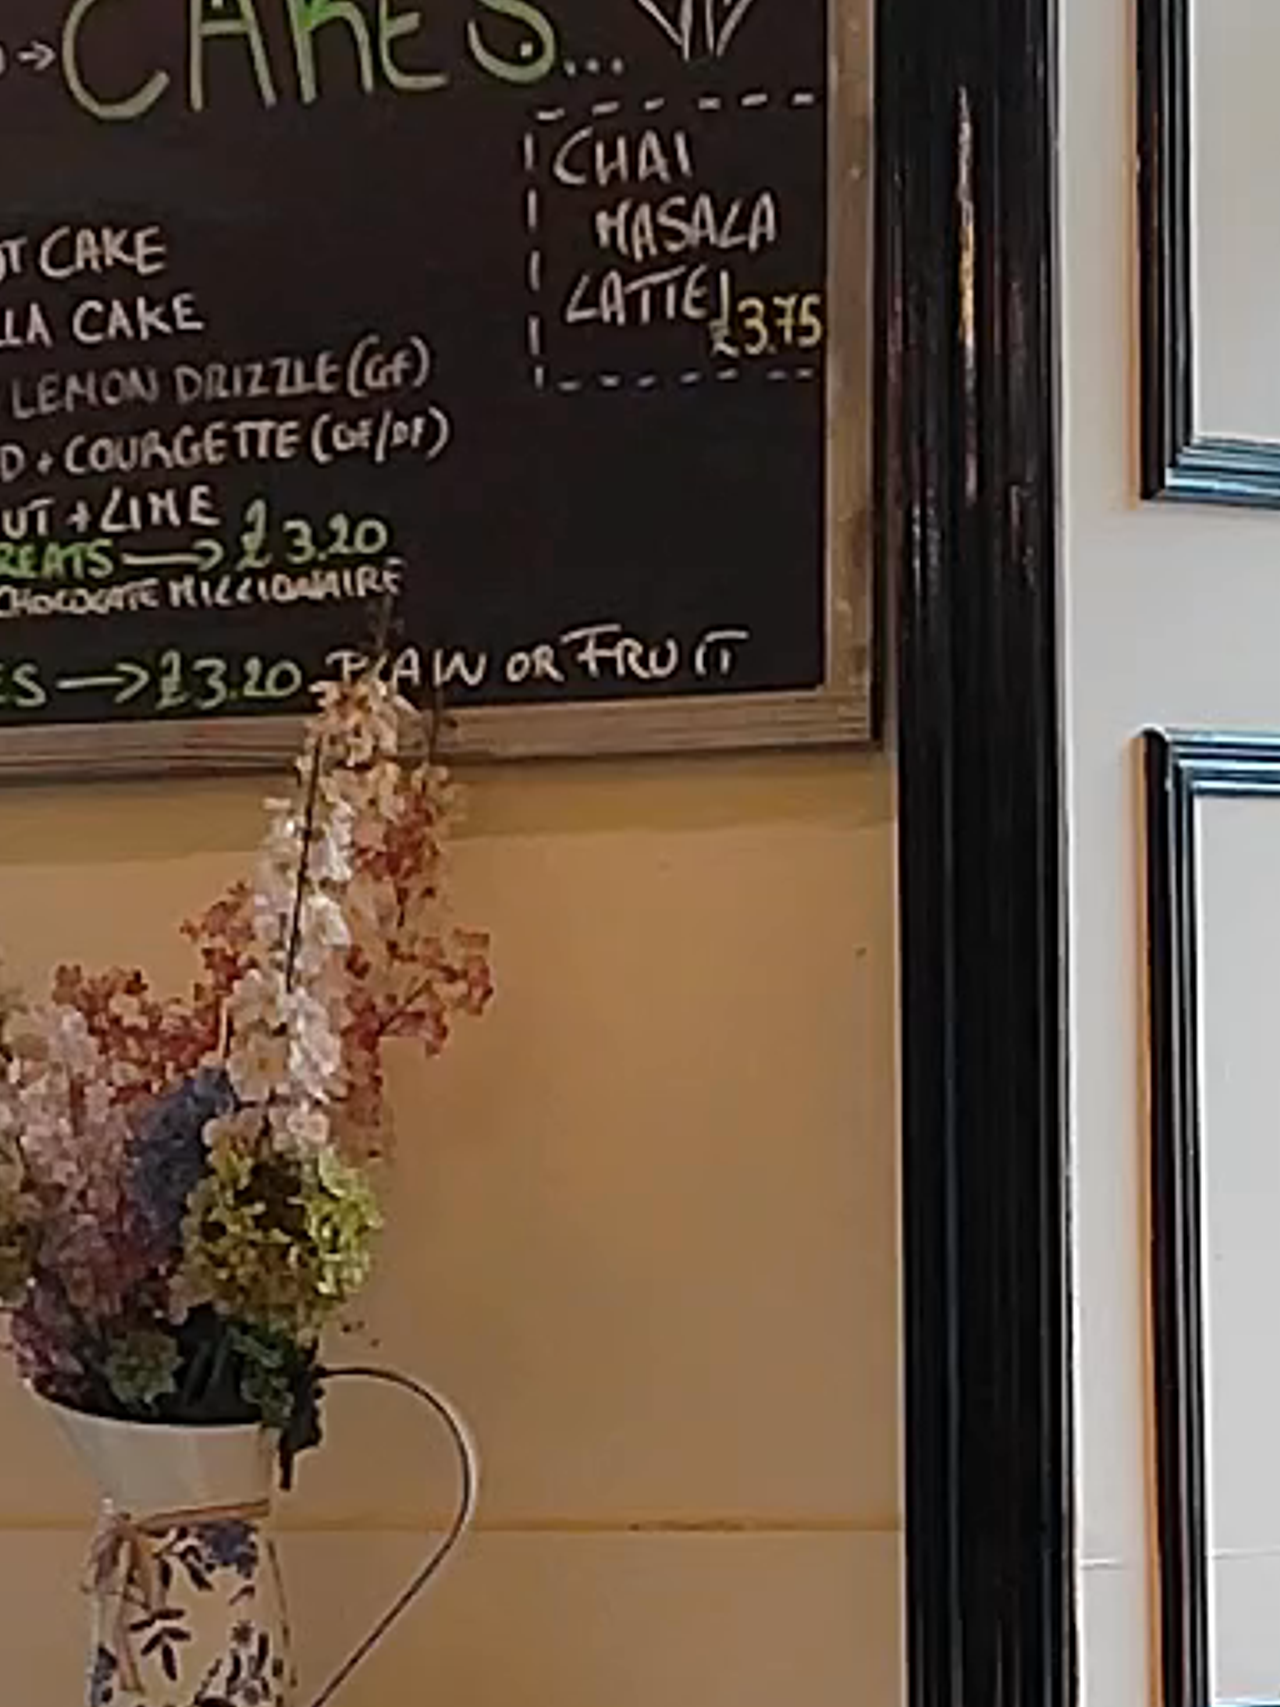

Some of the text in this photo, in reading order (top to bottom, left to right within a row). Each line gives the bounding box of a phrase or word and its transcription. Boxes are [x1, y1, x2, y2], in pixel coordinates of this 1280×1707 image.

[553, 127, 692, 185] CHAI
[39, 226, 167, 278] CAKE
[595, 193, 777, 261] MASALA
[72, 294, 204, 342] CAKE
[566, 265, 708, 324] LATTE
[12, 367, 159, 419] LEMON
[174, 350, 340, 405] DRIZZLE
[64, 419, 301, 475] COURGETTE
[100, 483, 221, 533] LIME
[235, 498, 389, 571] £3.20
[169, 557, 407, 609] MILLIONAIRE
[154, 647, 303, 711] £3.20
[505, 644, 565, 683] OR
[560, 623, 749, 680] FRUIT
